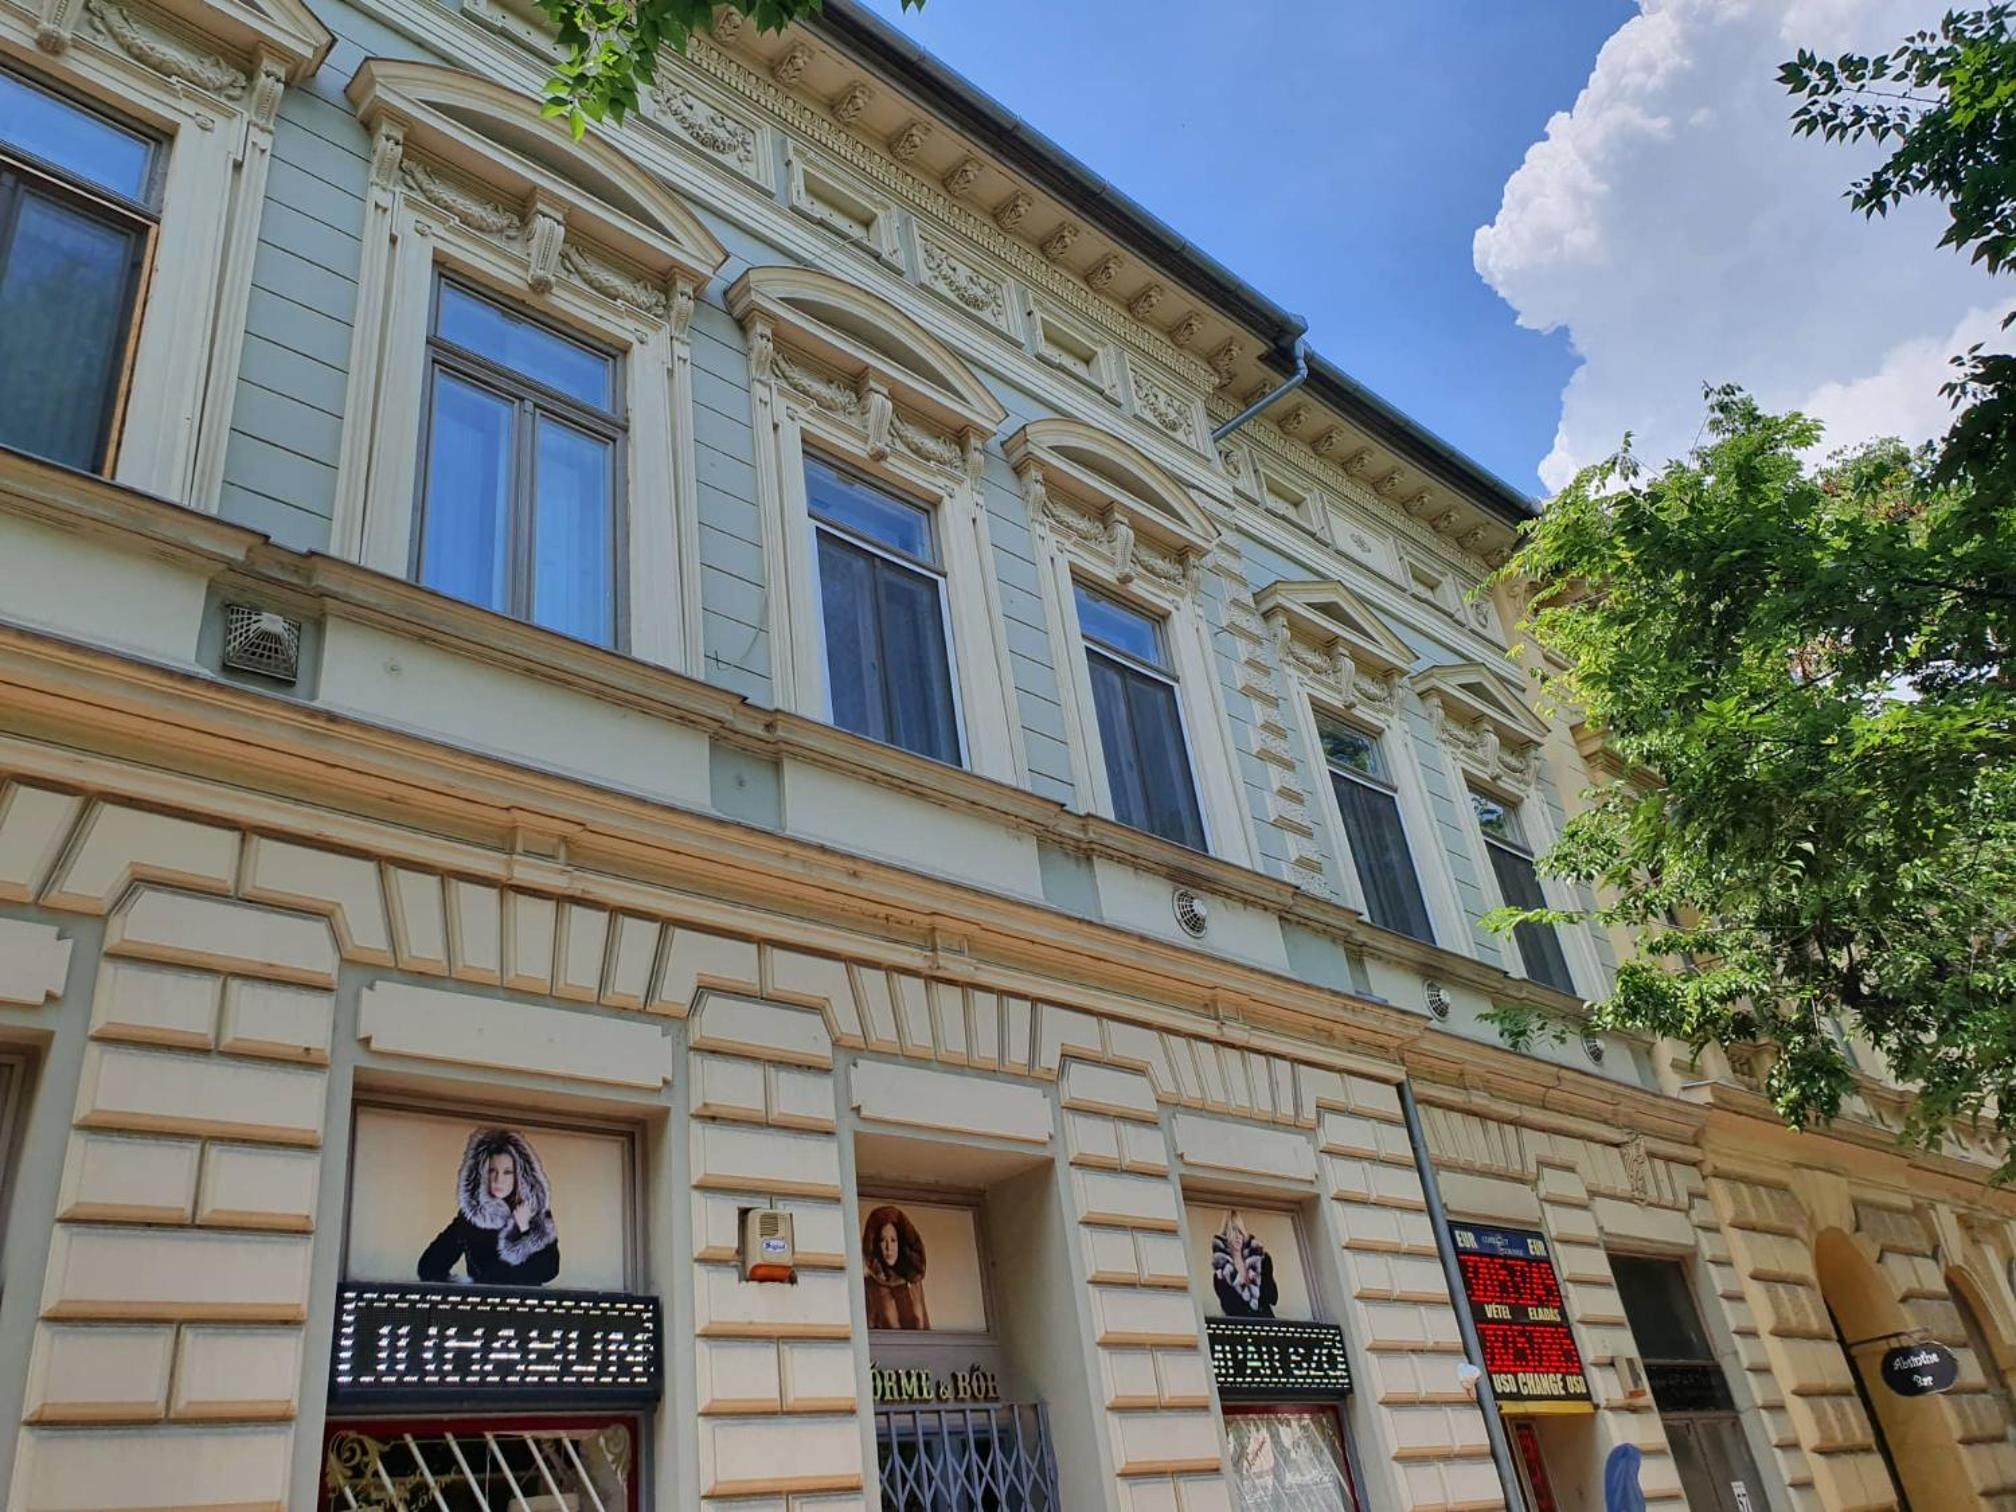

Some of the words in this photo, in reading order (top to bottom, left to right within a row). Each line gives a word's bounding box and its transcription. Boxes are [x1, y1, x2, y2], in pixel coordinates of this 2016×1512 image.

[1454, 1230, 1478, 1248] EUR
[1527, 1239, 1547, 1256] EUR
[1485, 1303, 1512, 1319] VÉTEL
[1528, 1307, 1561, 1321] ELADÁS
[1492, 1374, 1517, 1393] USD
[1518, 1372, 1566, 1396] CHANGE
[1567, 1376, 1587, 1394] USD
